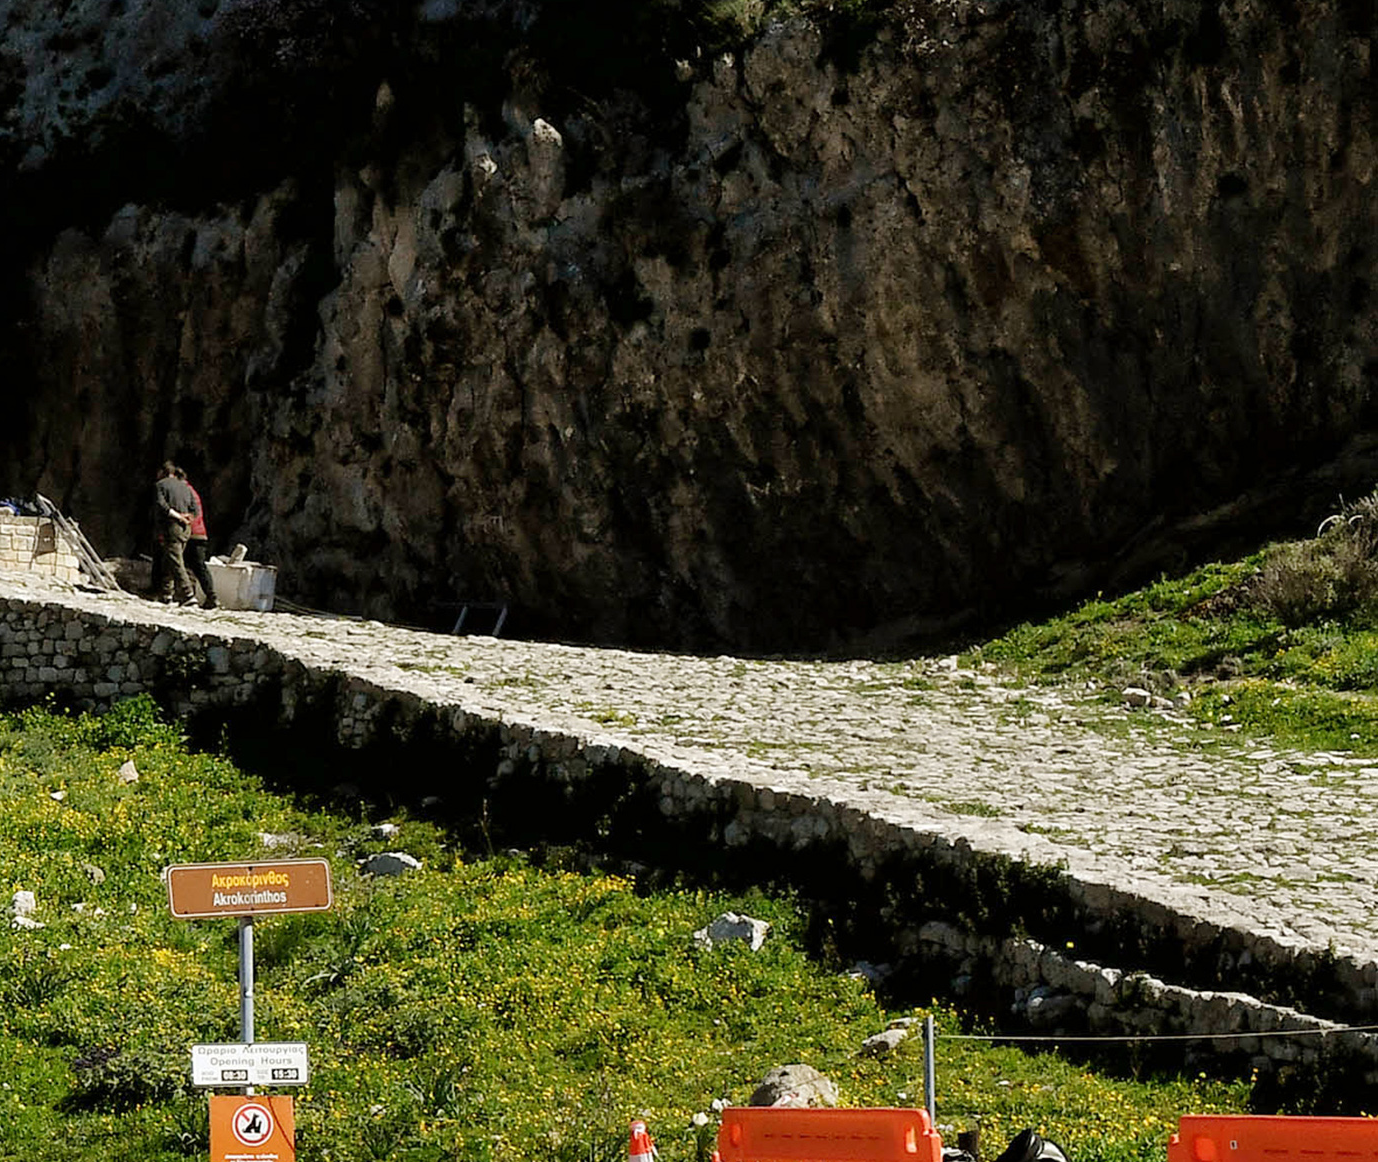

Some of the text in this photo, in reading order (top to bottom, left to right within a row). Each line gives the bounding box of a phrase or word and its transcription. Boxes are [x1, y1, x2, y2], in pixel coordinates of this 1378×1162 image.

[213, 889, 287, 906] Akrokorinthos
[210, 1056, 292, 1066] Opening Hours
